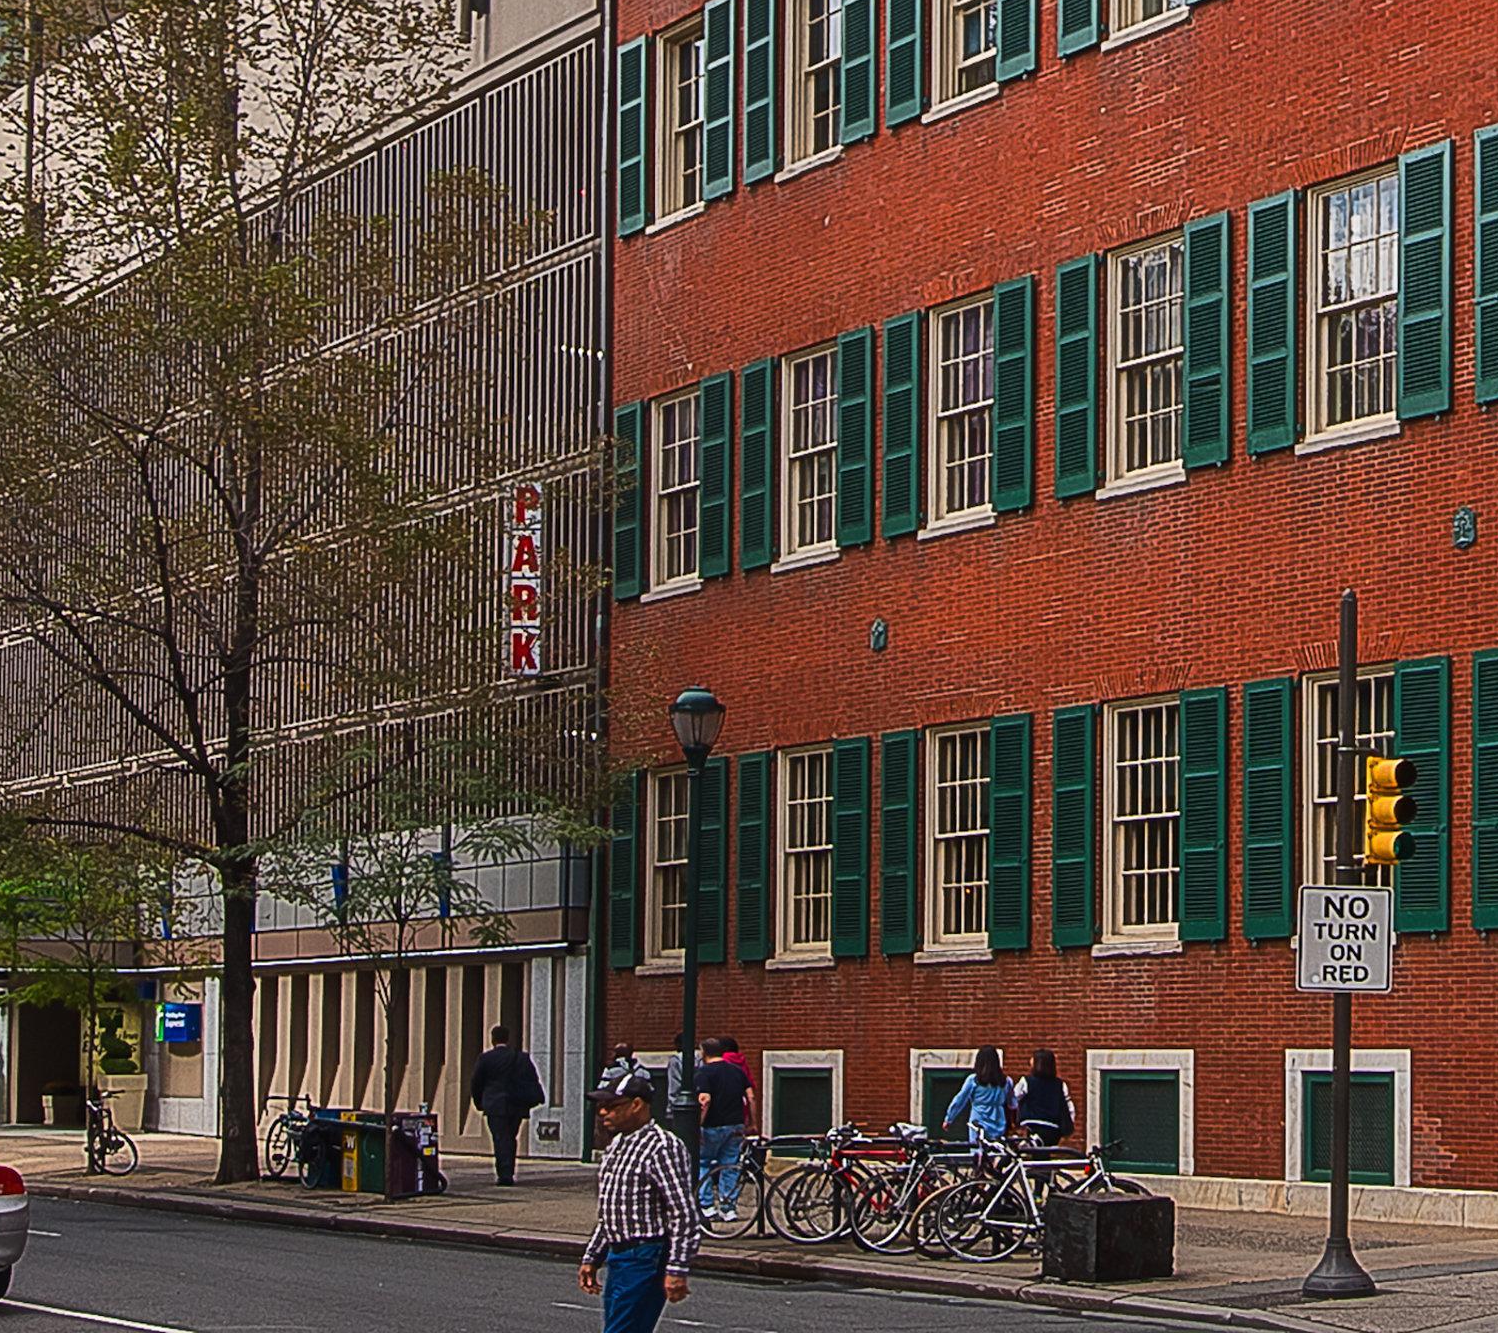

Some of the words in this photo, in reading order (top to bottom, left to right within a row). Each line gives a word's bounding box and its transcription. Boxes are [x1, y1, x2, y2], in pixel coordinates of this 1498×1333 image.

[511, 484, 540, 670] PARK
[1324, 895, 1370, 919] NO
[1313, 923, 1377, 941] TURN
[1330, 944, 1362, 962] ON
[1322, 965, 1370, 983] RED
